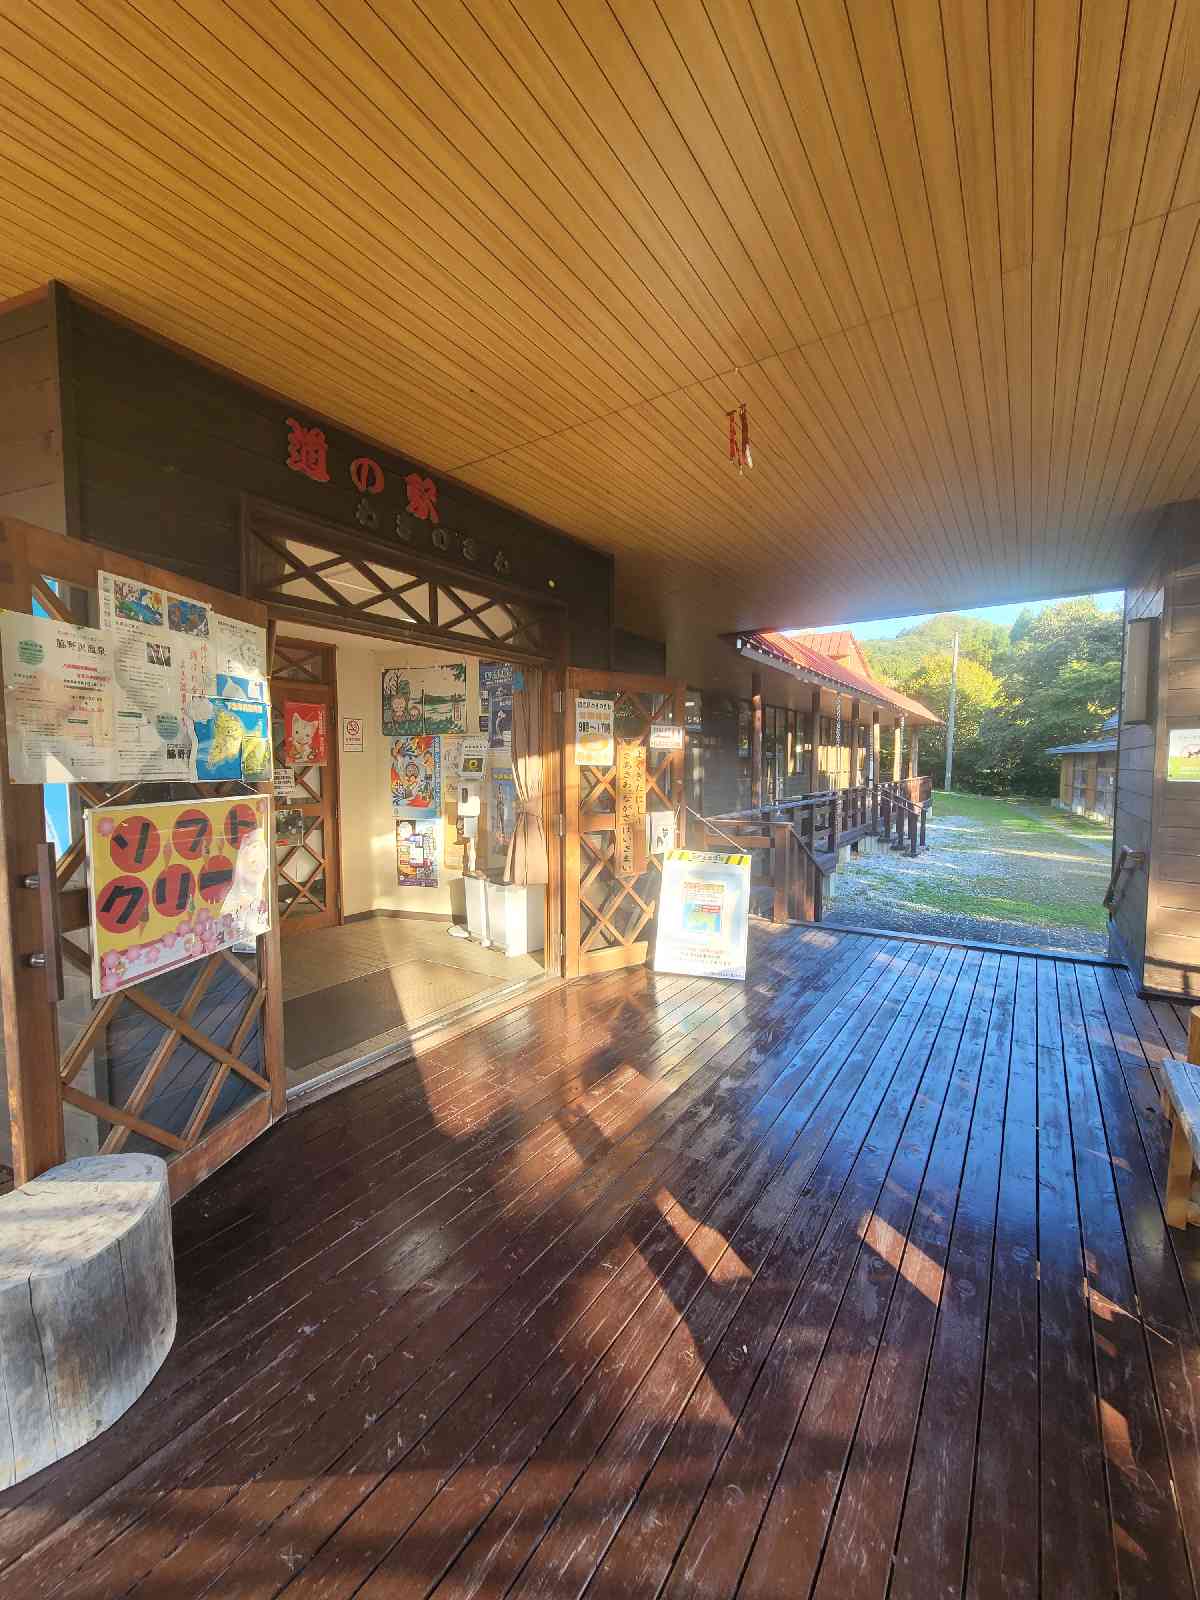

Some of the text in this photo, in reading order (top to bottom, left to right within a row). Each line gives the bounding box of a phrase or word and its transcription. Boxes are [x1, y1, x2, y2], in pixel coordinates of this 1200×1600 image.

[286, 417, 440, 523] 道の駅
[112, 807, 257, 864] ソフト
